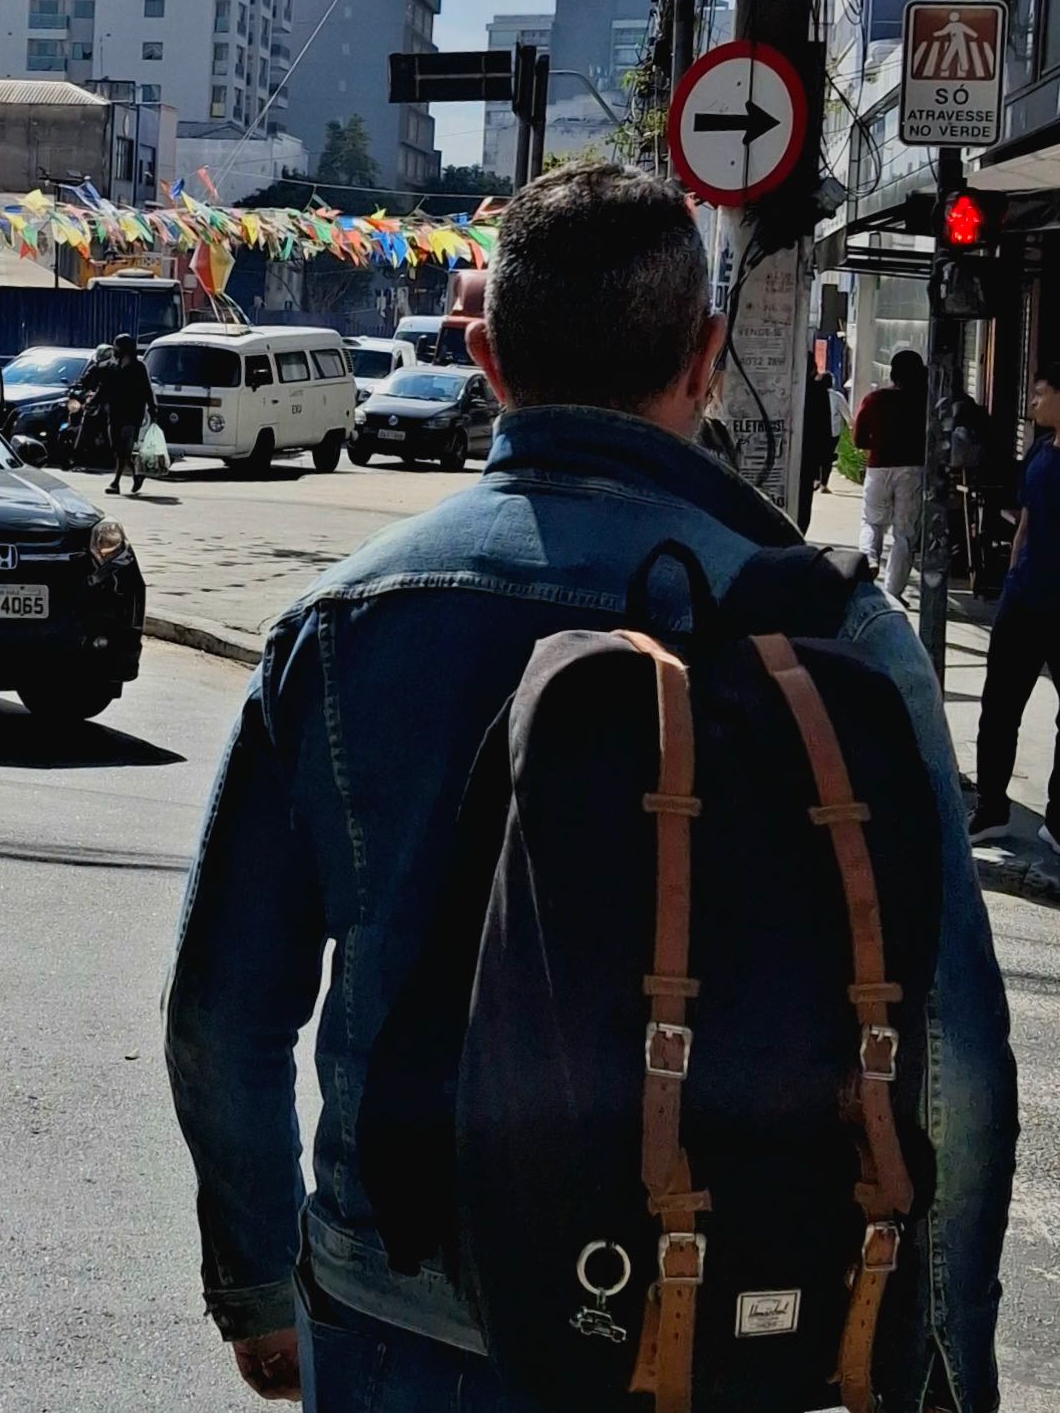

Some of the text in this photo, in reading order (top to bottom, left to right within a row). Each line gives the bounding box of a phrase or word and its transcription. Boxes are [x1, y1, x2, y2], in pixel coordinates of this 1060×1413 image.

[934, 84, 969, 105] SÓ
[907, 109, 994, 123] ATRAVESSE
[909, 124, 991, 138] NO VERDE
